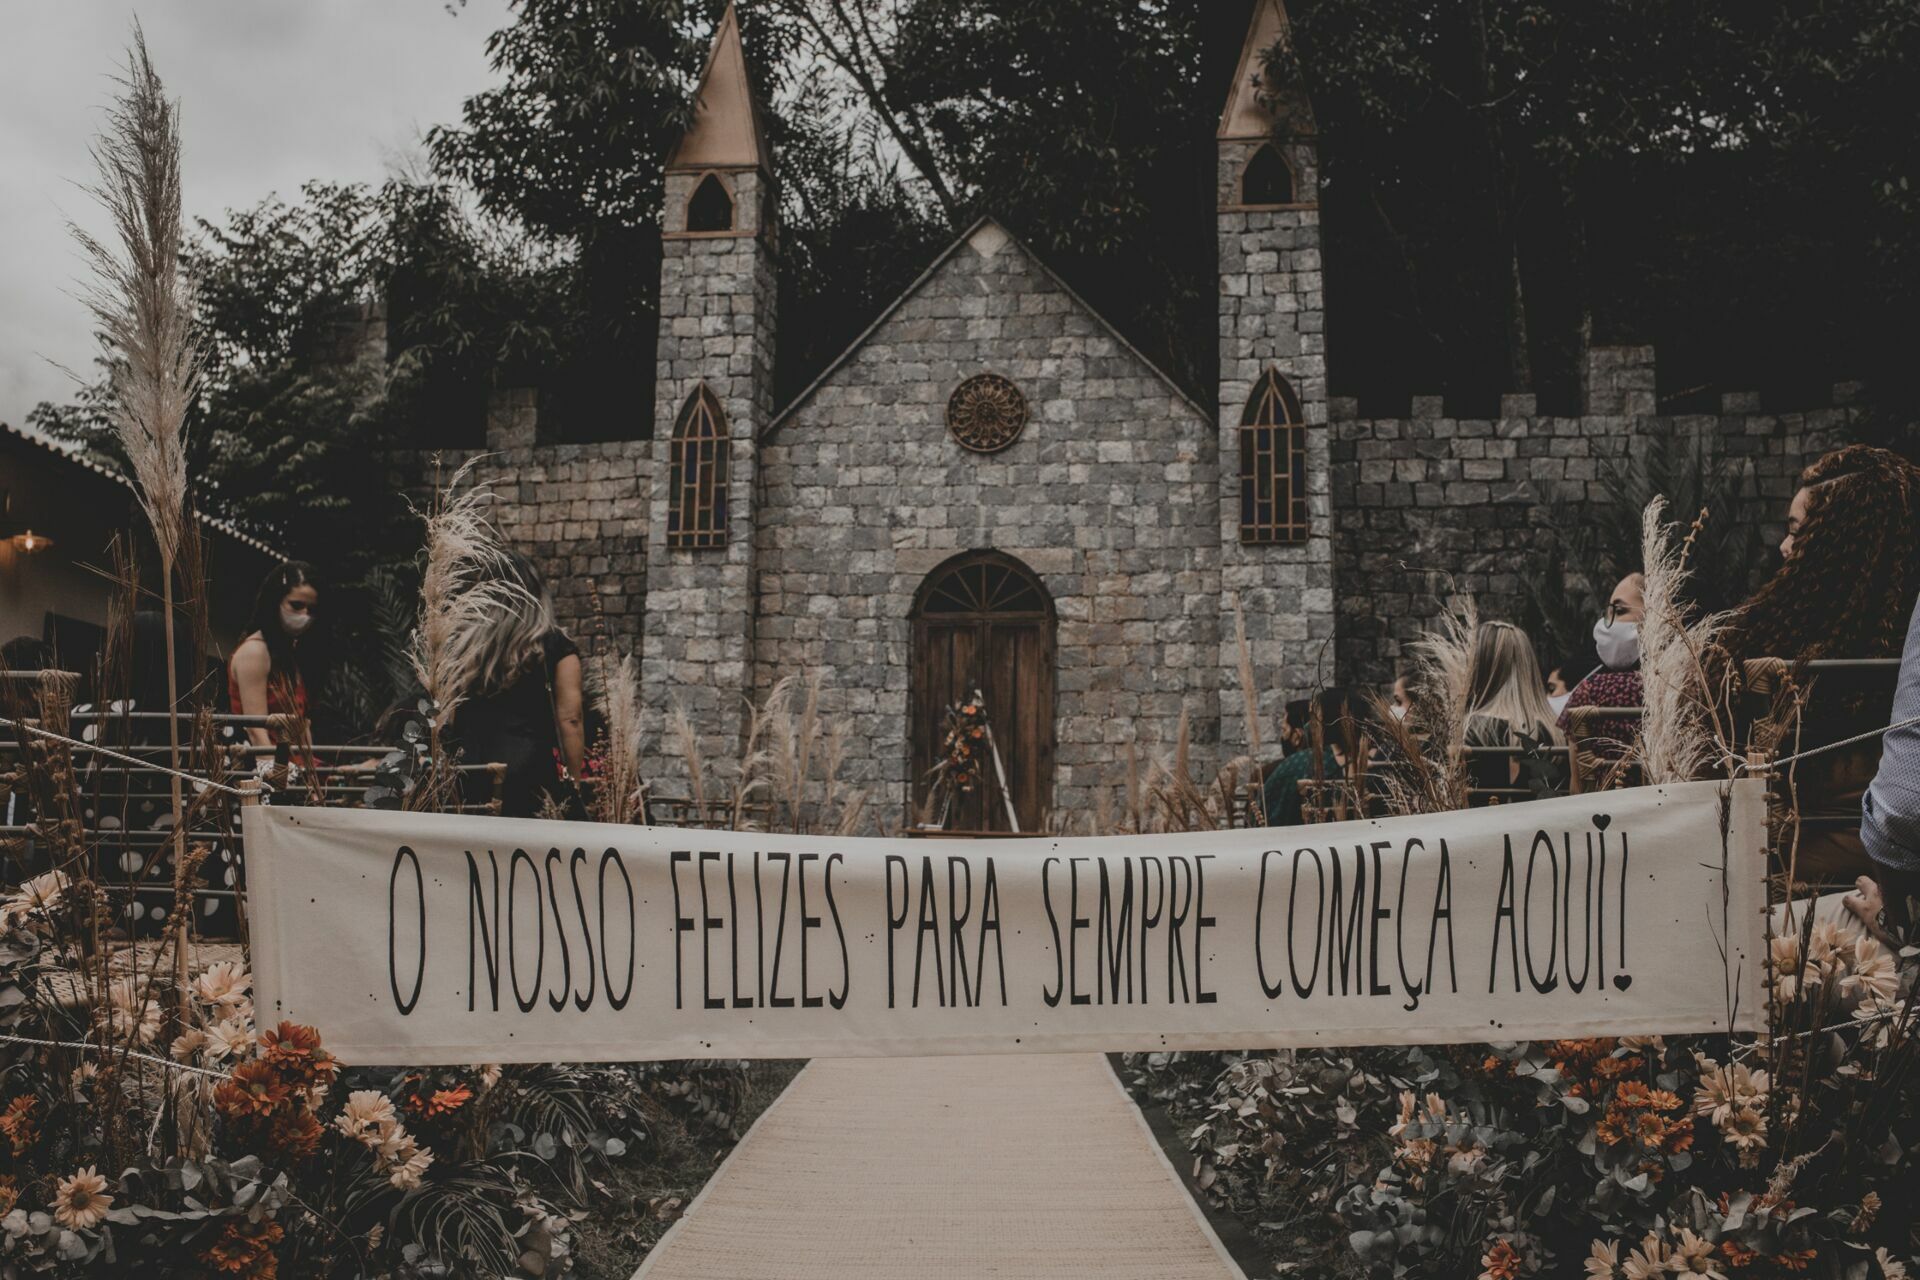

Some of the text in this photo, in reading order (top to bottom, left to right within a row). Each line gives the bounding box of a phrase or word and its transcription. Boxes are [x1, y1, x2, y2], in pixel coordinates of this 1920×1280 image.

[388, 845, 426, 1017] O
[463, 846, 635, 1014] NOSSO
[669, 850, 850, 1011] FELIZES
[885, 854, 1008, 1009] PARA
[1041, 854, 1218, 1008] SEMPRE
[1254, 837, 1458, 1012] COMEÇA
